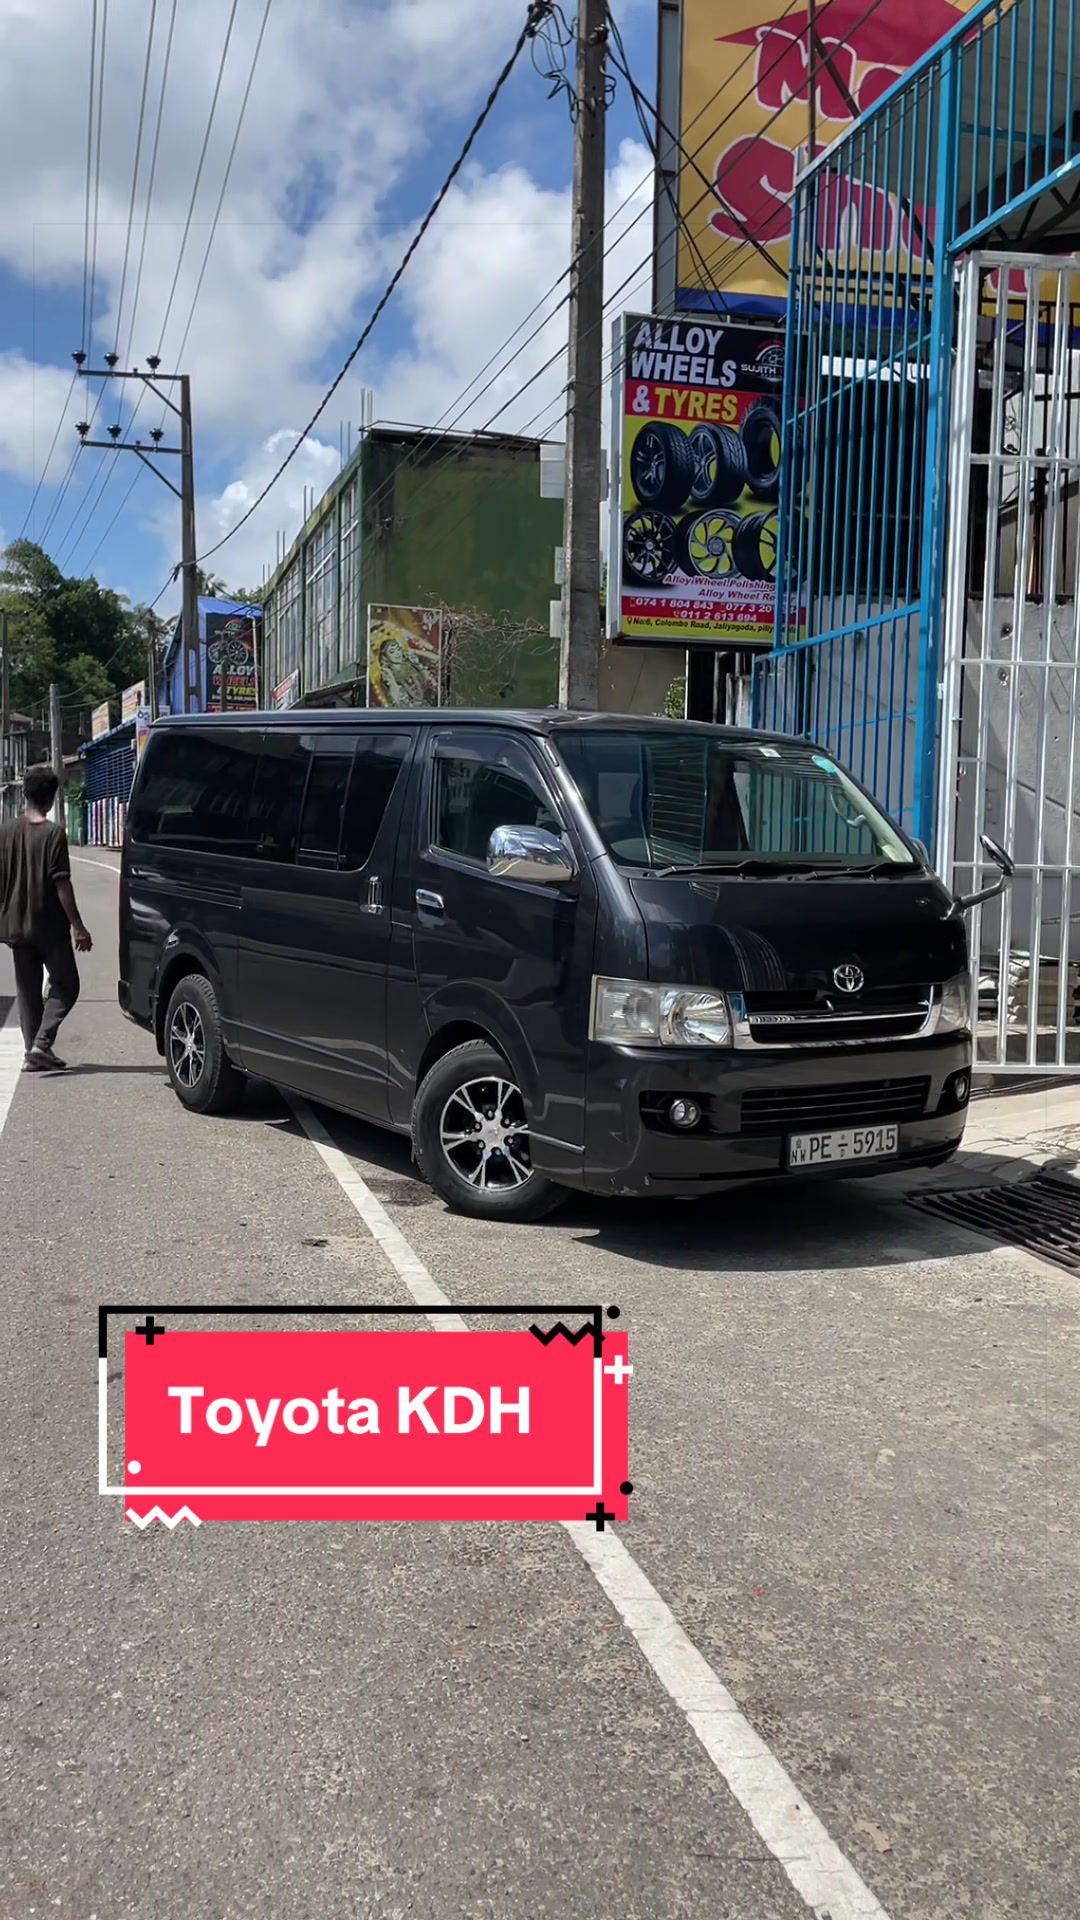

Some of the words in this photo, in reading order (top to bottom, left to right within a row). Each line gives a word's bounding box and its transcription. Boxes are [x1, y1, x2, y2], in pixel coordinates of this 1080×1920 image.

[633, 321, 724, 355] ALLOY
[631, 352, 737, 388] WHEELS
[740, 363, 777, 375] SUJITH
[632, 384, 651, 414] &
[655, 387, 739, 422] TYRES
[664, 574, 692, 585] Alloy
[695, 576, 727, 586] Wheel
[698, 589, 725, 600] Alloy
[727, 591, 760, 600] Wheel
[635, 597, 657, 607] 074
[660, 599, 666, 607] 1
[725, 603, 746, 612] 077
[749, 604, 756, 612] 3
[681, 610, 700, 619] 011
[704, 611, 711, 619] 2
[714, 612, 734, 621] 613
[737, 613, 757, 622] 694
[655, 619, 688, 628] Colombo
